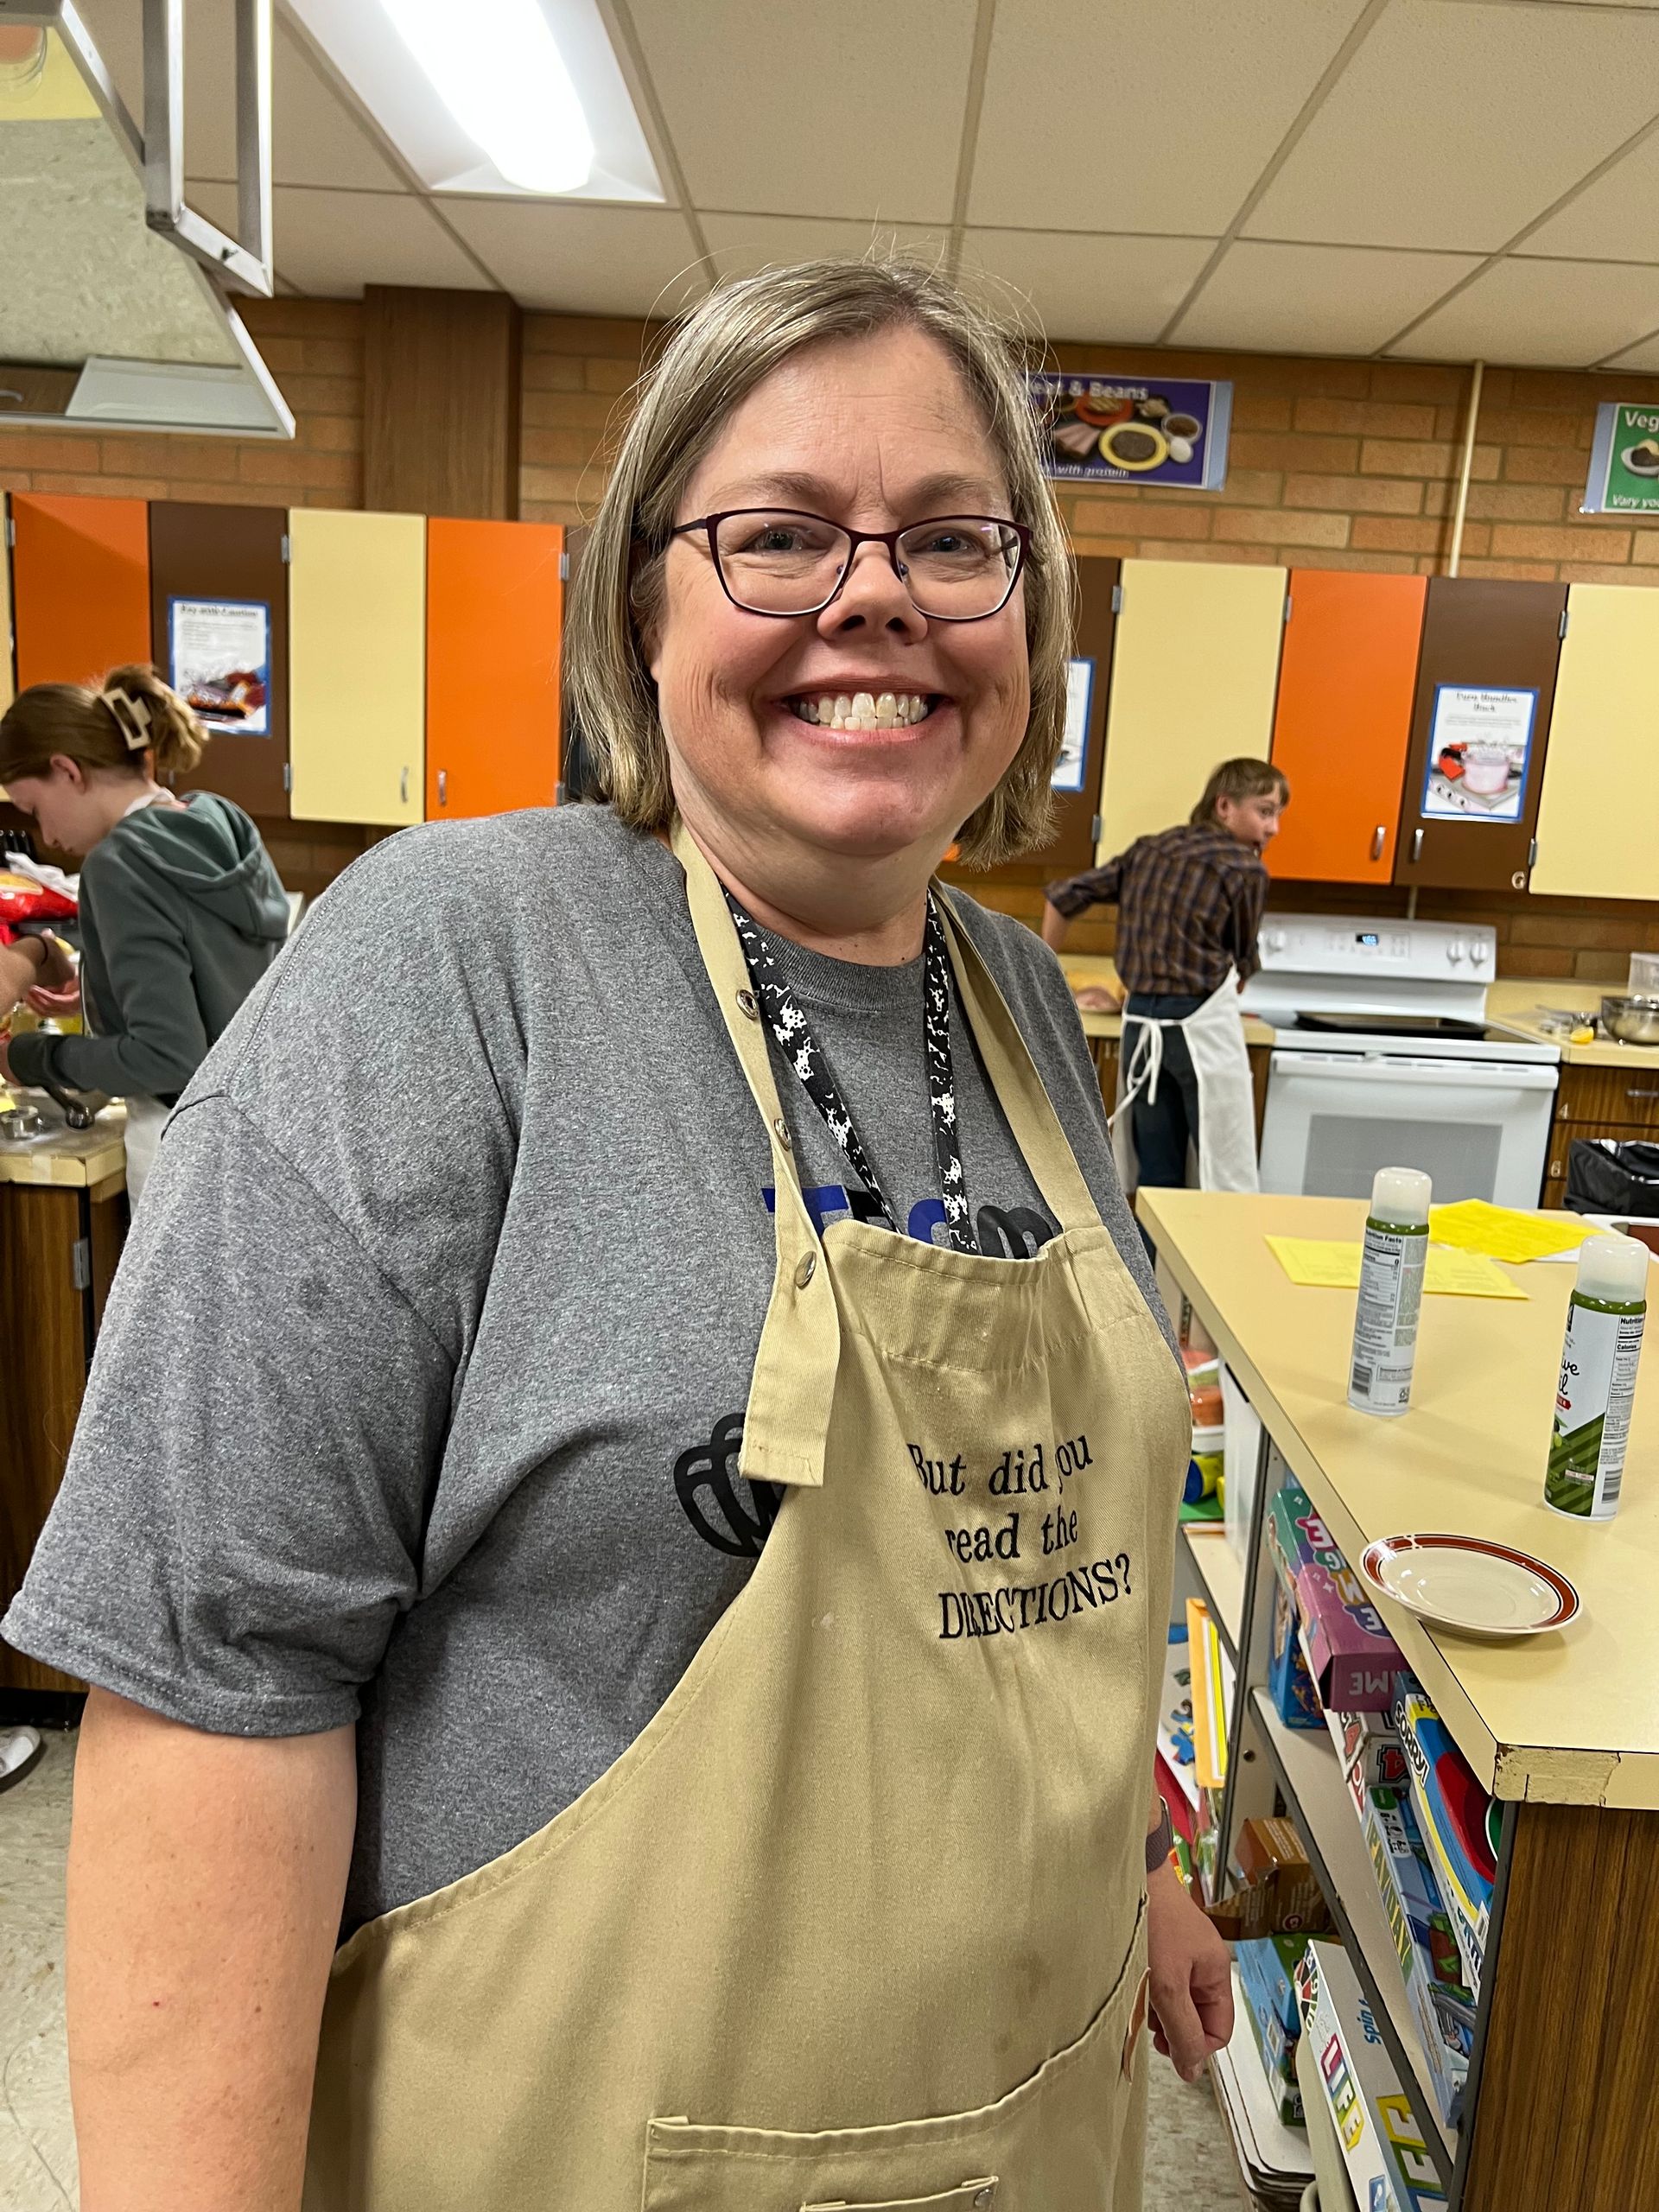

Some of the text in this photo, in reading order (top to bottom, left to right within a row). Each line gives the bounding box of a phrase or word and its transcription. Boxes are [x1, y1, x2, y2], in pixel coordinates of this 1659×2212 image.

[1090, 382, 1148, 400] Beans
[1057, 465, 1081, 475] with
[1612, 494, 1639, 509] Vary
[907, 1443, 967, 1496] But
[988, 1443, 1049, 1496] did
[944, 1504, 1078, 1564] read the
[1322, 2035, 1364, 2152] LIFE
